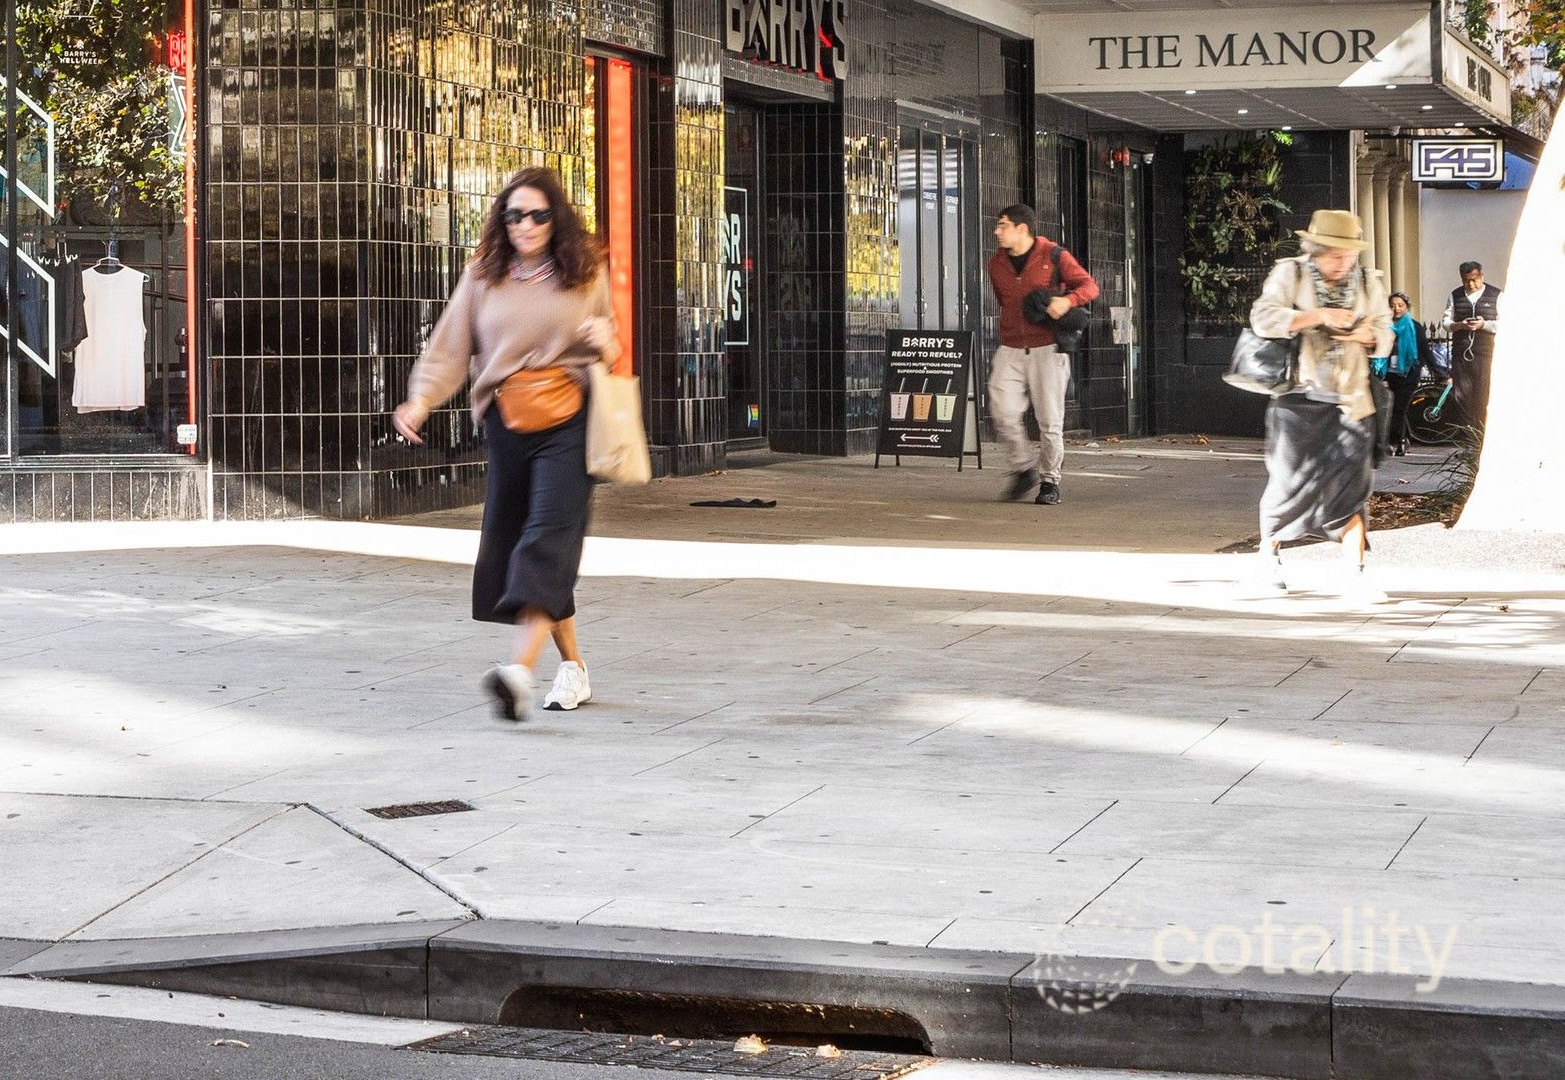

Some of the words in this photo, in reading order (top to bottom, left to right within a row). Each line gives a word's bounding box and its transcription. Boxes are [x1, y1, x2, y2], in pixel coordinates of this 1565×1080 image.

[64, 50, 97, 58] BARRY'S
[1088, 35, 1182, 69] THE
[1195, 29, 1382, 67] MANOR
[1423, 146, 1492, 175] F45
[902, 337, 955, 349] BARRY'S
[930, 351, 963, 359] REFUEL?
